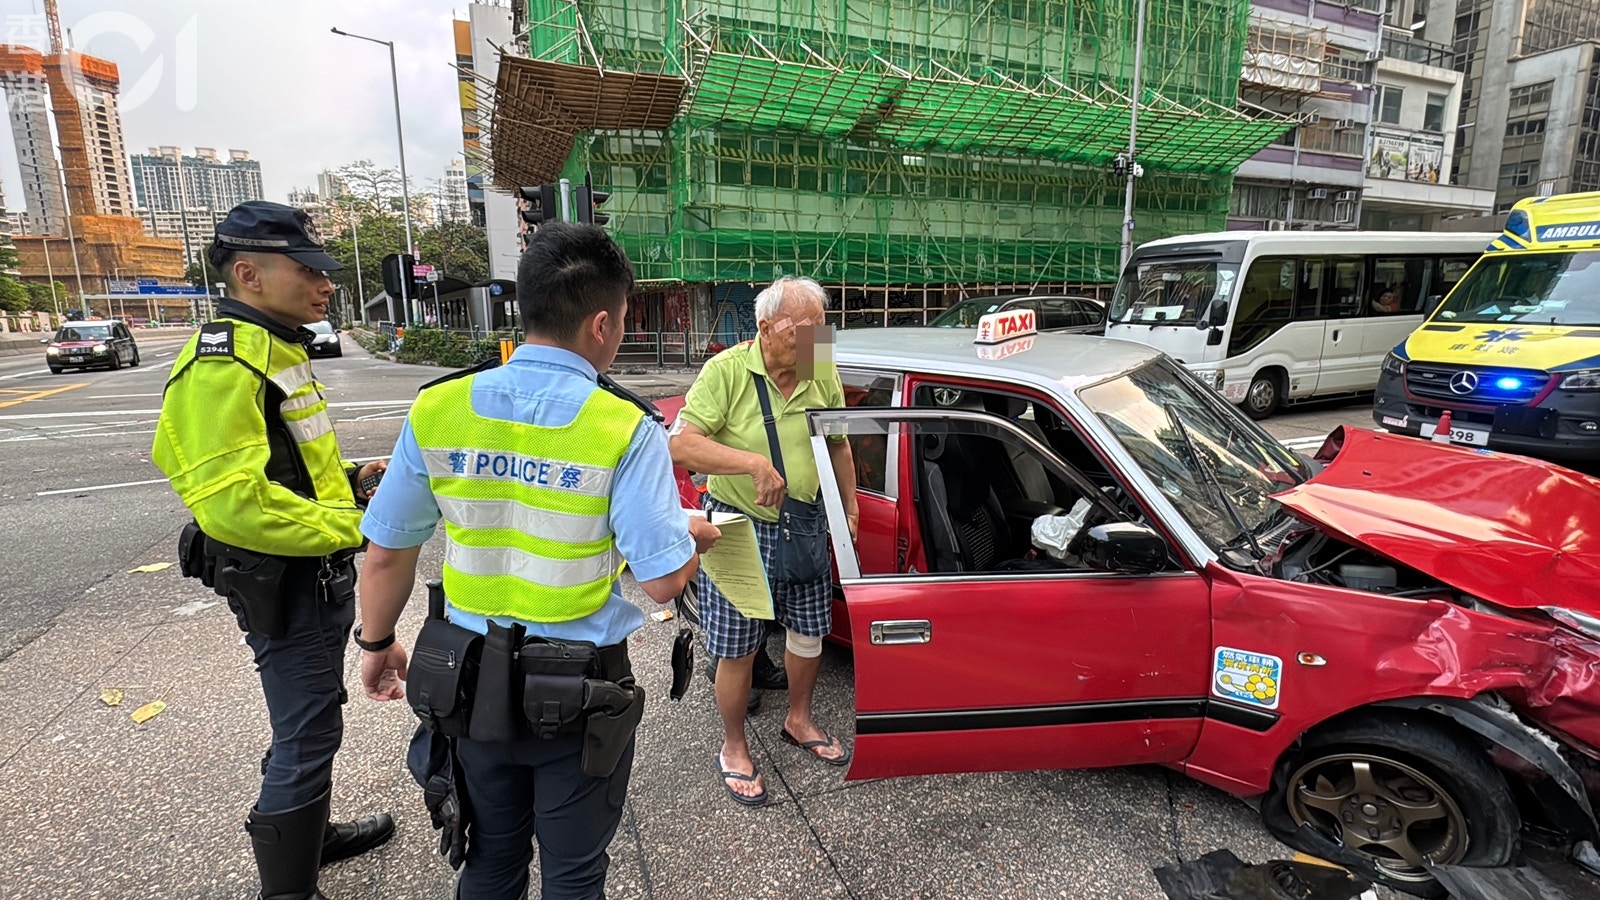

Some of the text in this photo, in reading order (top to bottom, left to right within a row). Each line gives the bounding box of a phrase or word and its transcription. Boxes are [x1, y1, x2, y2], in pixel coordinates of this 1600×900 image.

[1541, 225, 1600, 238] AMBUL
[981, 321, 991, 337] 的士
[998, 313, 1033, 335] TAXI
[448, 452, 582, 489] 警 POLICE 察
